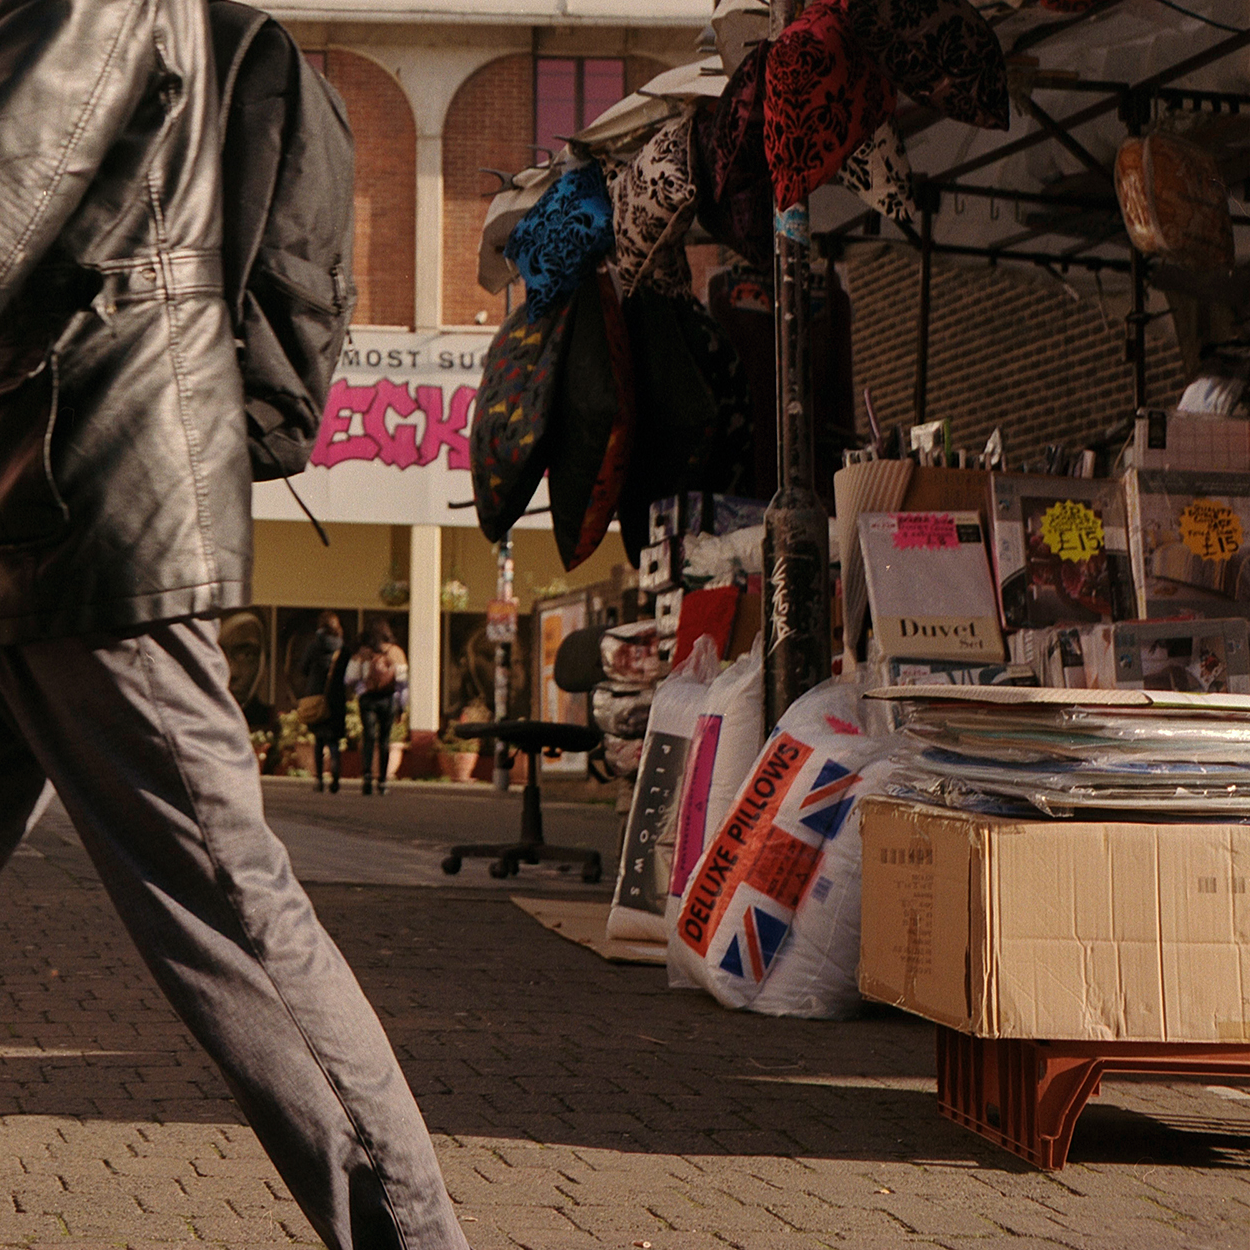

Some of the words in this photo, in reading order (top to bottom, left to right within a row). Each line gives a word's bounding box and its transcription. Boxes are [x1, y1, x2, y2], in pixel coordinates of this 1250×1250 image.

[341, 349, 421, 369] MOST
[439, 353, 486, 370] SU
[1058, 530, 1102, 553] £15
[1201, 534, 1240, 557] £15
[899, 617, 977, 638] Duvet
[959, 638, 984, 650] Set
[629, 743, 673, 897] PILLOWS
[684, 845, 739, 943] DELUXE
[727, 742, 800, 846] PILLOWS
